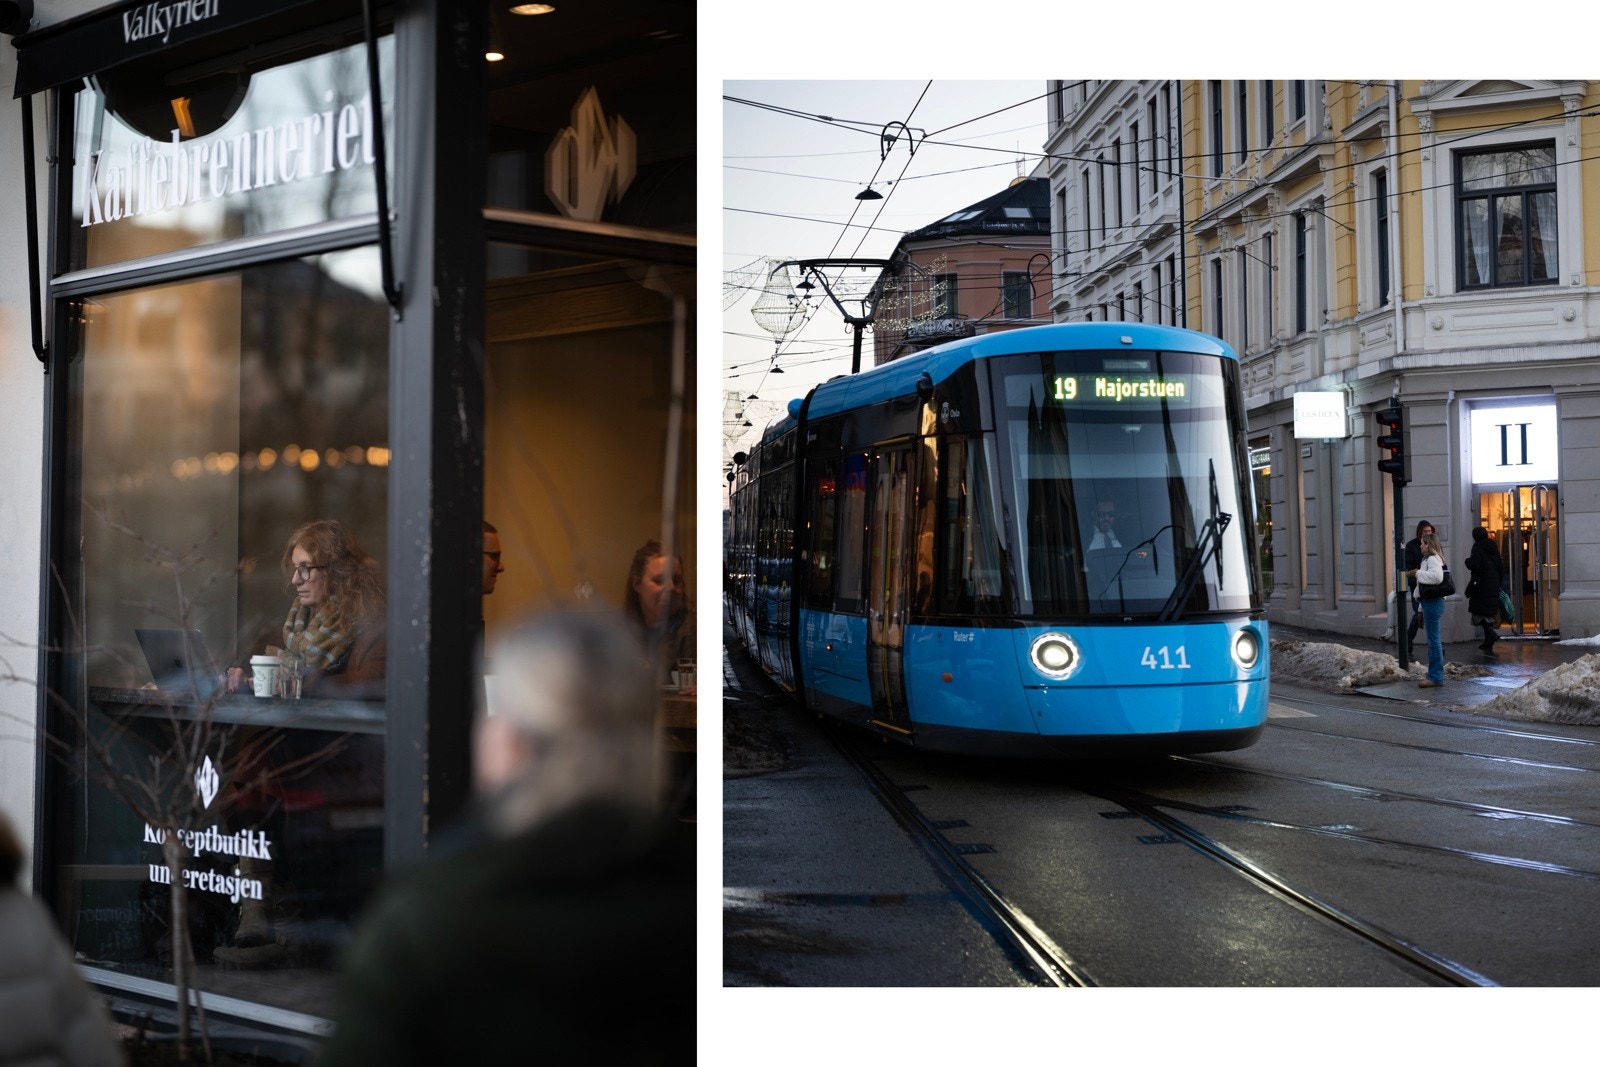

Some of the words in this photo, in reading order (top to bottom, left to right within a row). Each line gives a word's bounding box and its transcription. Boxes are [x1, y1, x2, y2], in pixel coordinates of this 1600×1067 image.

[123, 0, 219, 43] Valkyrien
[1054, 377, 1077, 400] 19
[1095, 377, 1185, 401] Majorstuen
[1141, 646, 1191, 670] 411
[143, 822, 272, 860] Koseptbutikk
[149, 864, 263, 904] uneretasjen
